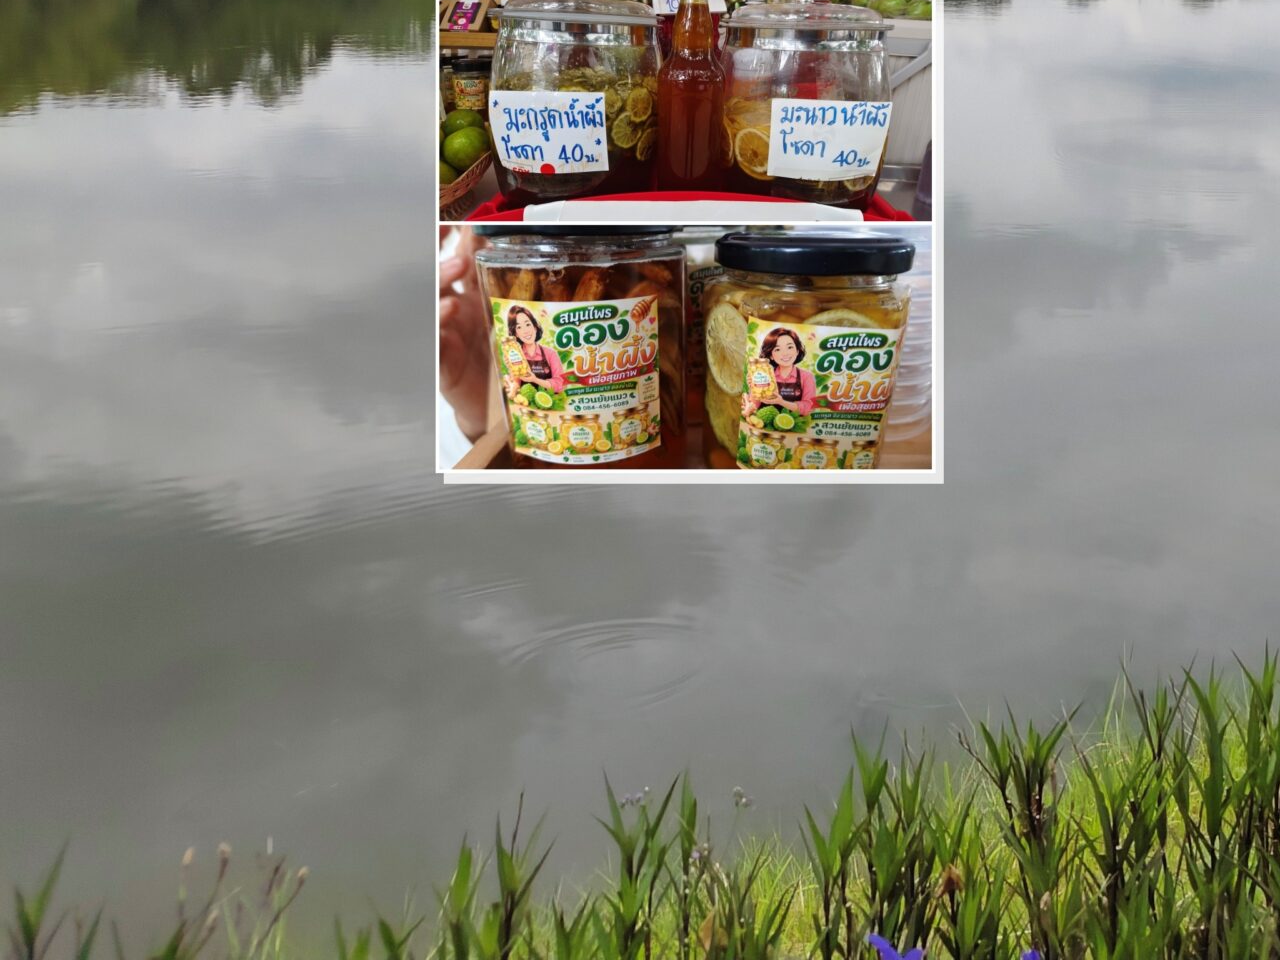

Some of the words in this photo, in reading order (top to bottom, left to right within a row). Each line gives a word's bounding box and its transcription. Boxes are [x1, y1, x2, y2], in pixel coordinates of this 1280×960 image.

[559, 306, 613, 326] สมุนไพร
[555, 318, 630, 349] ดอง
[826, 333, 882, 351] สมุนไพร
[573, 335, 656, 376] น้ำผึ้ง
[816, 349, 894, 373] ดอง
